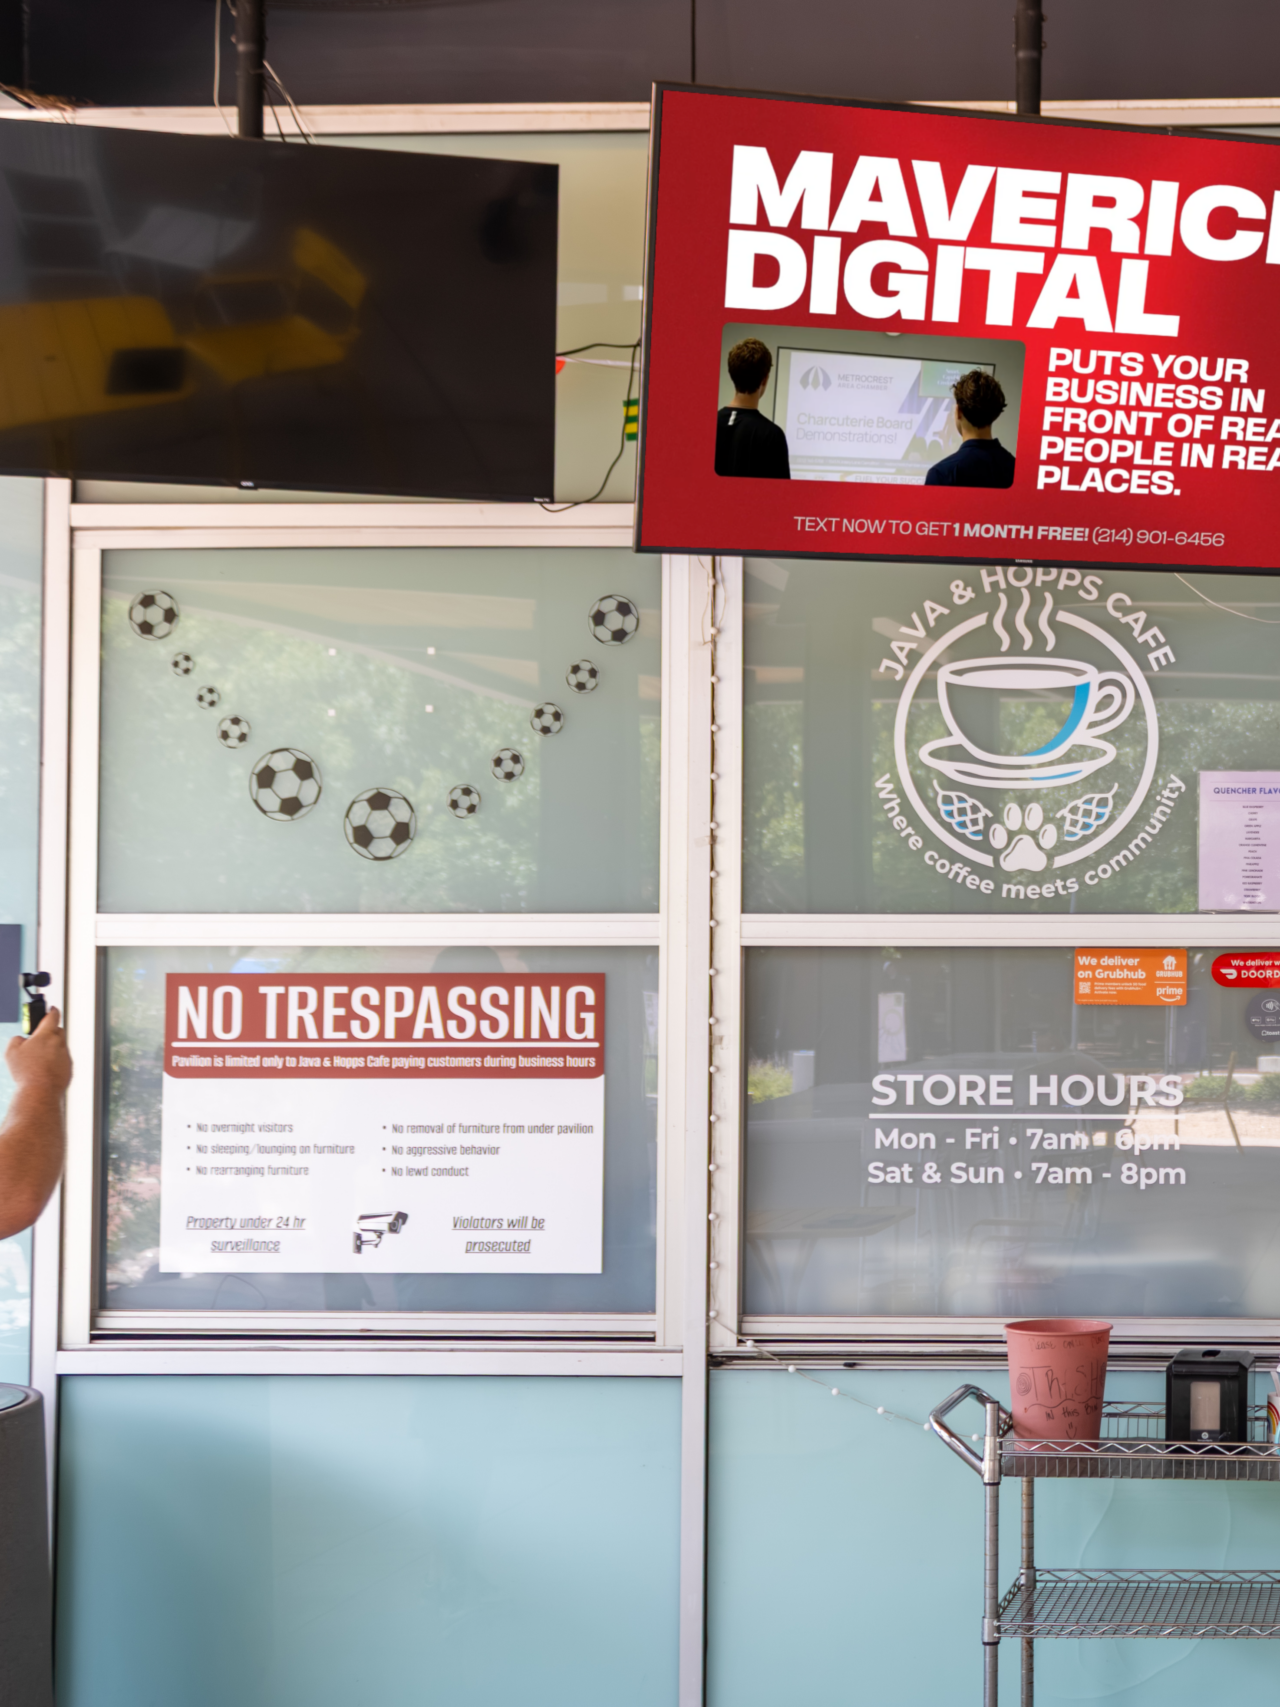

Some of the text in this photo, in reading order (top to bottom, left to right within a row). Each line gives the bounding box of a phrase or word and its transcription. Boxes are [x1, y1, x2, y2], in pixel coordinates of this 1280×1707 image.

[724, 229, 1180, 337] DIGITAL
[1048, 347, 1249, 383] PUTS YOUR
[837, 373, 894, 384] METROCREST
[1046, 376, 1265, 413] BUSINESS IN
[797, 412, 913, 430] Charcuterie Board
[1042, 406, 1162, 436] FRONT
[1167, 413, 1214, 439] OF
[796, 428, 897, 444] Demonstrations!
[1039, 435, 1174, 466] PEOPLE
[1180, 442, 1215, 468] IN
[1037, 465, 1181, 496] PLACES.
[794, 516, 1225, 547] TEXT NOW TO GET 1 MONTH FREE! (214) 901-6456
[879, 566, 1176, 681] JAVA & HOPPS CAFE
[1213, 786, 1257, 794] QUENCHER
[874, 772, 924, 850] Where
[924, 850, 995, 894] coffee
[1002, 877, 1080, 900] meets
[1084, 774, 1186, 886] community
[1078, 956, 1140, 966] We deliver
[1078, 969, 1146, 979] on Grubhub
[1156, 970, 1183, 978] GRUBHUB
[1156, 986, 1183, 996] prime
[177, 984, 597, 1040] NO TRESPASSING
[172, 1055, 596, 1069] Pavilion is limited only to Java & Hopps Cafe paying customers during business hours
[871, 1074, 1184, 1107] STORE HOURS
[196, 1122, 294, 1134] No overnight visitors
[392, 1124, 594, 1135] No removal of furniture from under pavilion
[874, 1126, 1180, 1156] Mon Fri 7am 6pm
[196, 1144, 354, 1156] No sleeping/lounging on furniture
[392, 1144, 500, 1157] No aggressive behavior
[196, 1165, 309, 1177] No rearranging furniture
[391, 1166, 469, 1176] No lewd conduct
[867, 1162, 1186, 1190] Sat & Sun 7am 8pm
[186, 1216, 306, 1230] Property under 24 hr
[453, 1216, 545, 1228] Violators will be
[210, 1238, 280, 1252] surveillance
[465, 1239, 531, 1253] prosecuted
[1062, 1406, 1080, 1418] this
